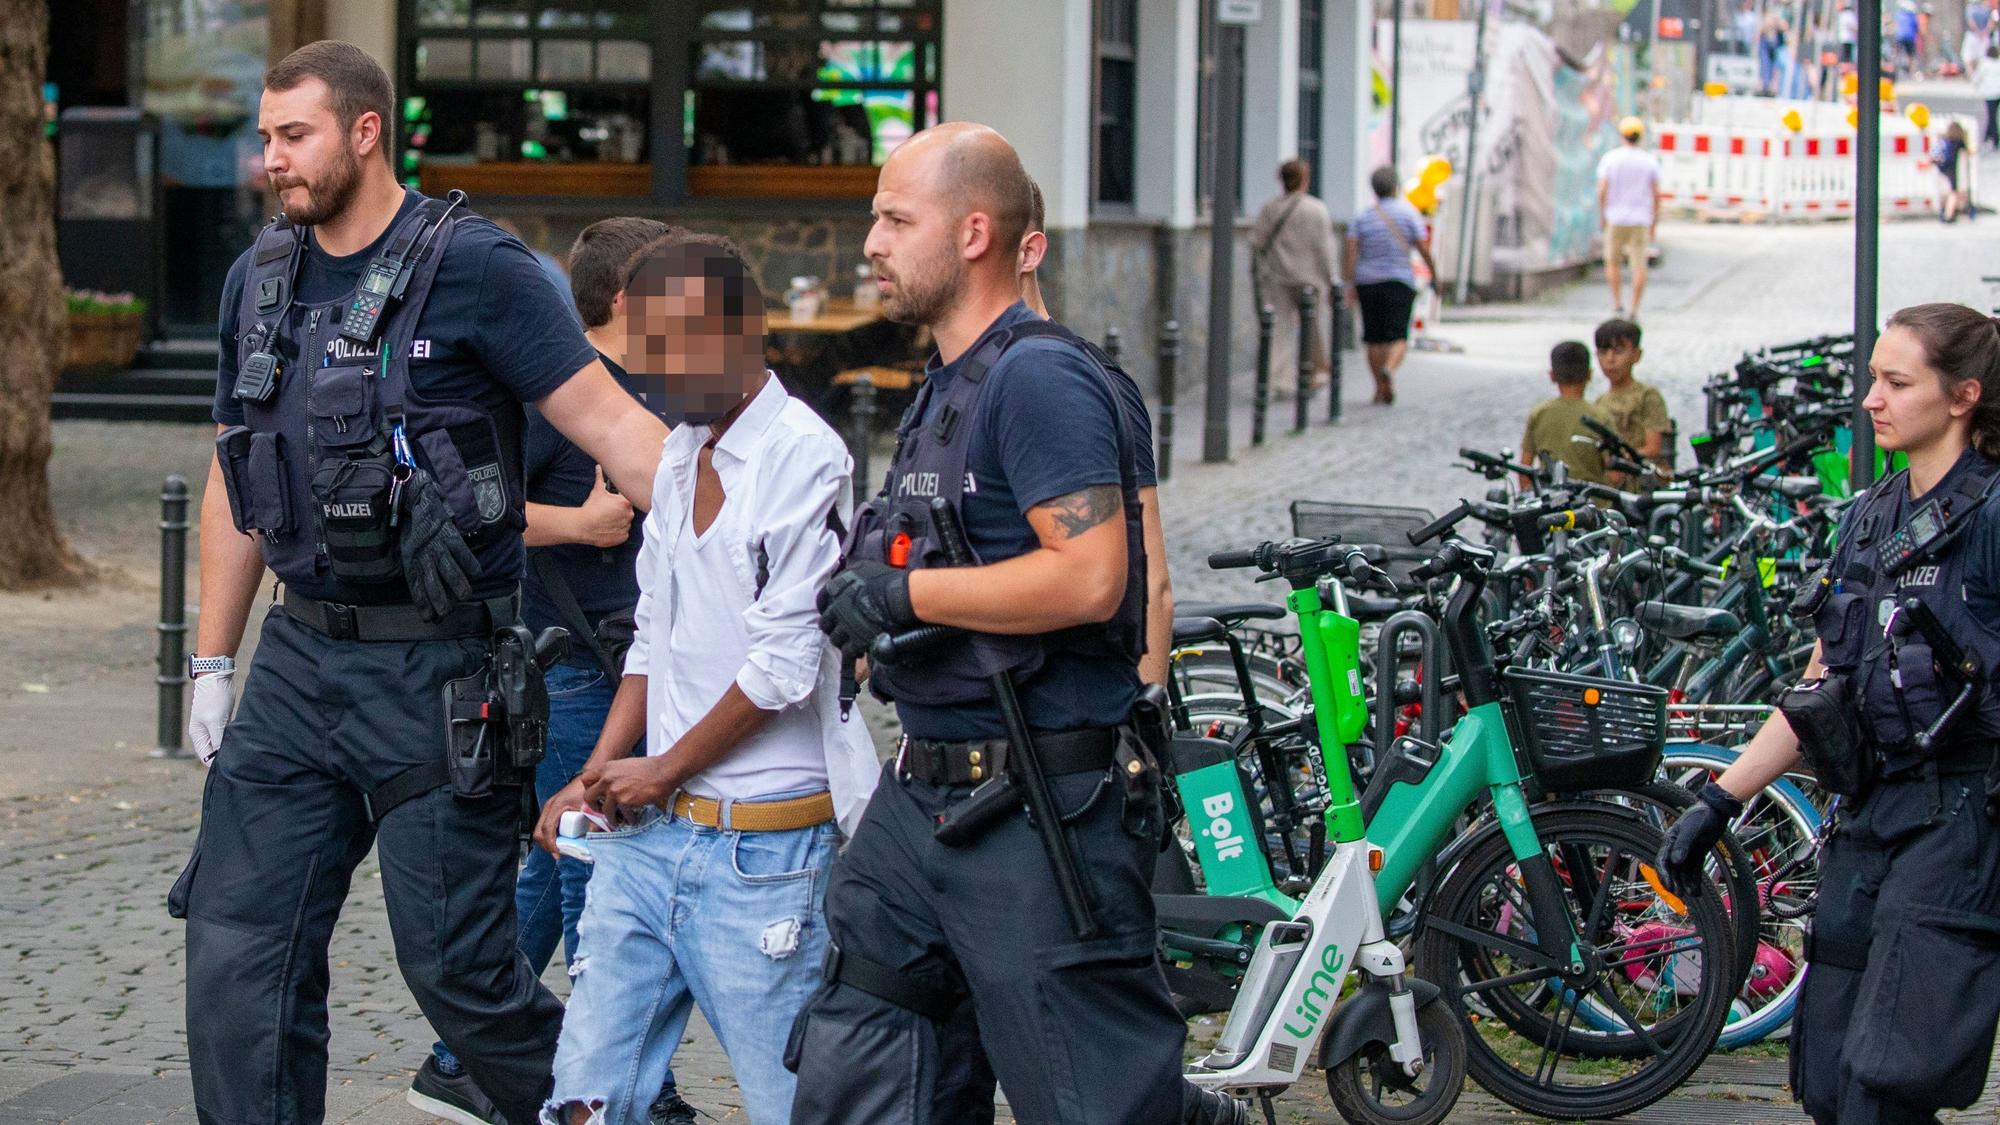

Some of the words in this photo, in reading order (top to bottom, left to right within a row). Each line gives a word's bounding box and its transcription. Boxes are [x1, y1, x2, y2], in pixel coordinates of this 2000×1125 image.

[468, 468, 498, 482] POLIZEI
[898, 472, 940, 497] POLIZEI
[323, 503, 372, 518] POLIZEI
[1202, 791, 1245, 862] Bolt
[1283, 943, 1344, 1039] Lime
